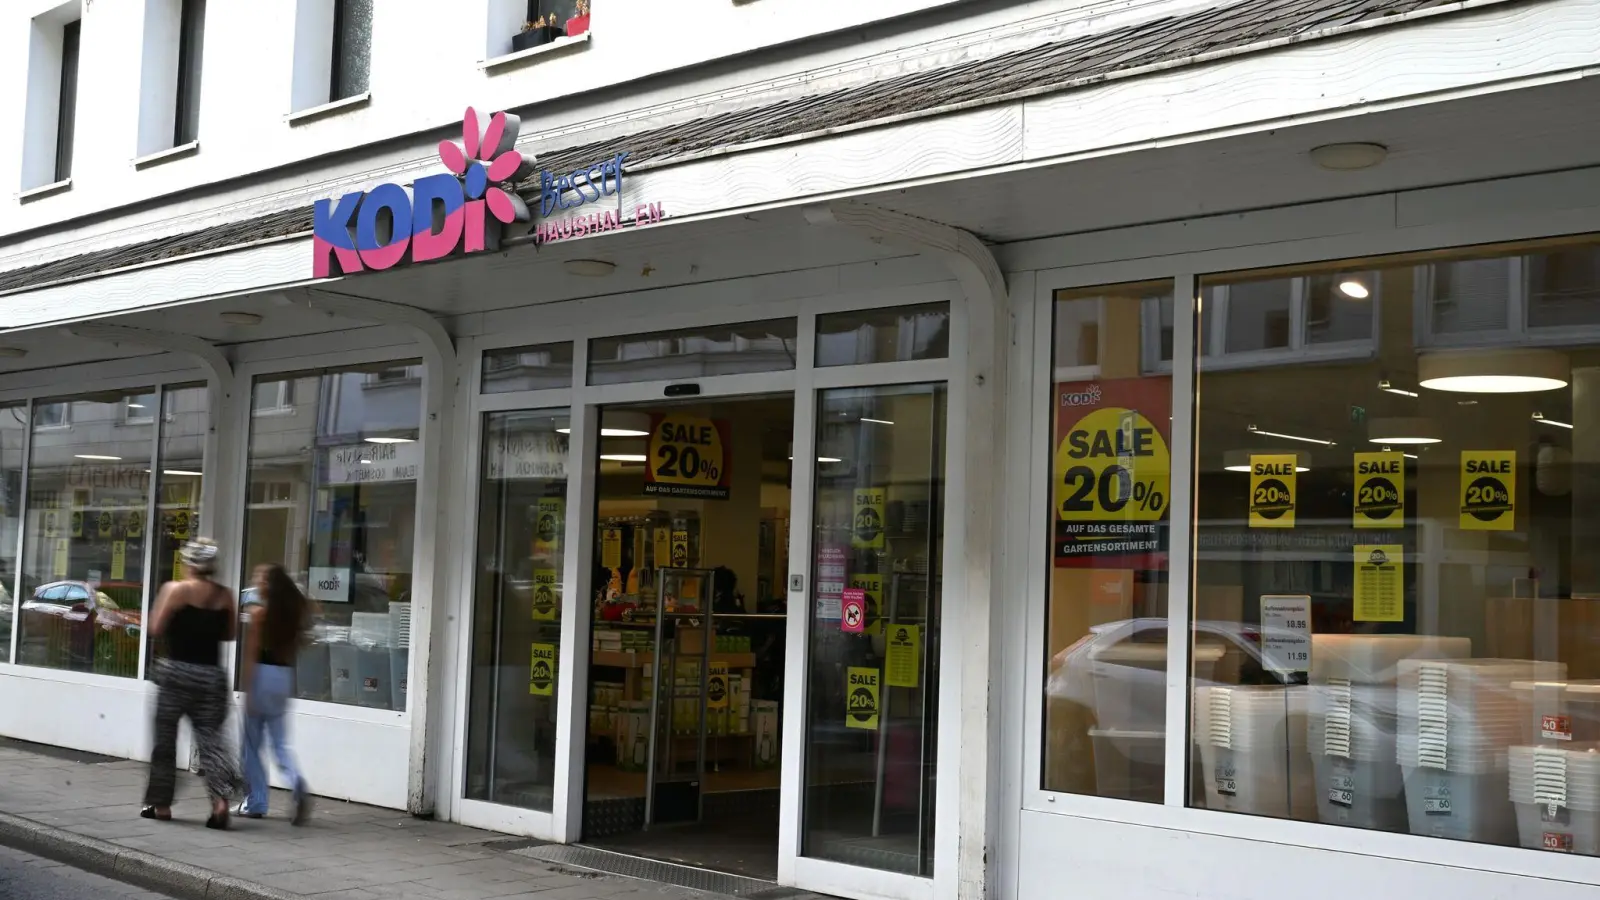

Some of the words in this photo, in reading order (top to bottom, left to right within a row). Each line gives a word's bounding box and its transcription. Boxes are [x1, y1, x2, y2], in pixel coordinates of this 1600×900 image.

[541, 151, 630, 218] Besser
[661, 422, 712, 446] SALE
[1067, 427, 1154, 459] SALE
[657, 445, 718, 479] 20%
[1358, 461, 1400, 474] SALE
[1465, 459, 1511, 473] SALE
[1254, 463, 1293, 475] SALE
[1063, 464, 1163, 513] 20%
[1361, 486, 1398, 503] 20%
[1467, 485, 1508, 504] 20%
[856, 495, 881, 505] SALE
[1255, 487, 1289, 504] 20%
[540, 503, 558, 512] SALE
[1066, 524, 1085, 533] AUF
[1087, 524, 1106, 533] DAS
[1109, 524, 1155, 533] GESAMTE
[672, 534, 688, 542] SALE
[1063, 540, 1158, 554] GARTENSORTIMENT
[536, 575, 555, 584] SALE
[852, 580, 879, 592] SALE
[533, 649, 553, 659] SALE
[850, 673, 876, 686] SALE
[851, 694, 875, 708] 20%
[1543, 720, 1557, 730] 40
[1227, 781, 1236, 790] 60
[1341, 792, 1352, 801] 60
[1439, 799, 1450, 808] 60
[1544, 836, 1558, 847] 40
